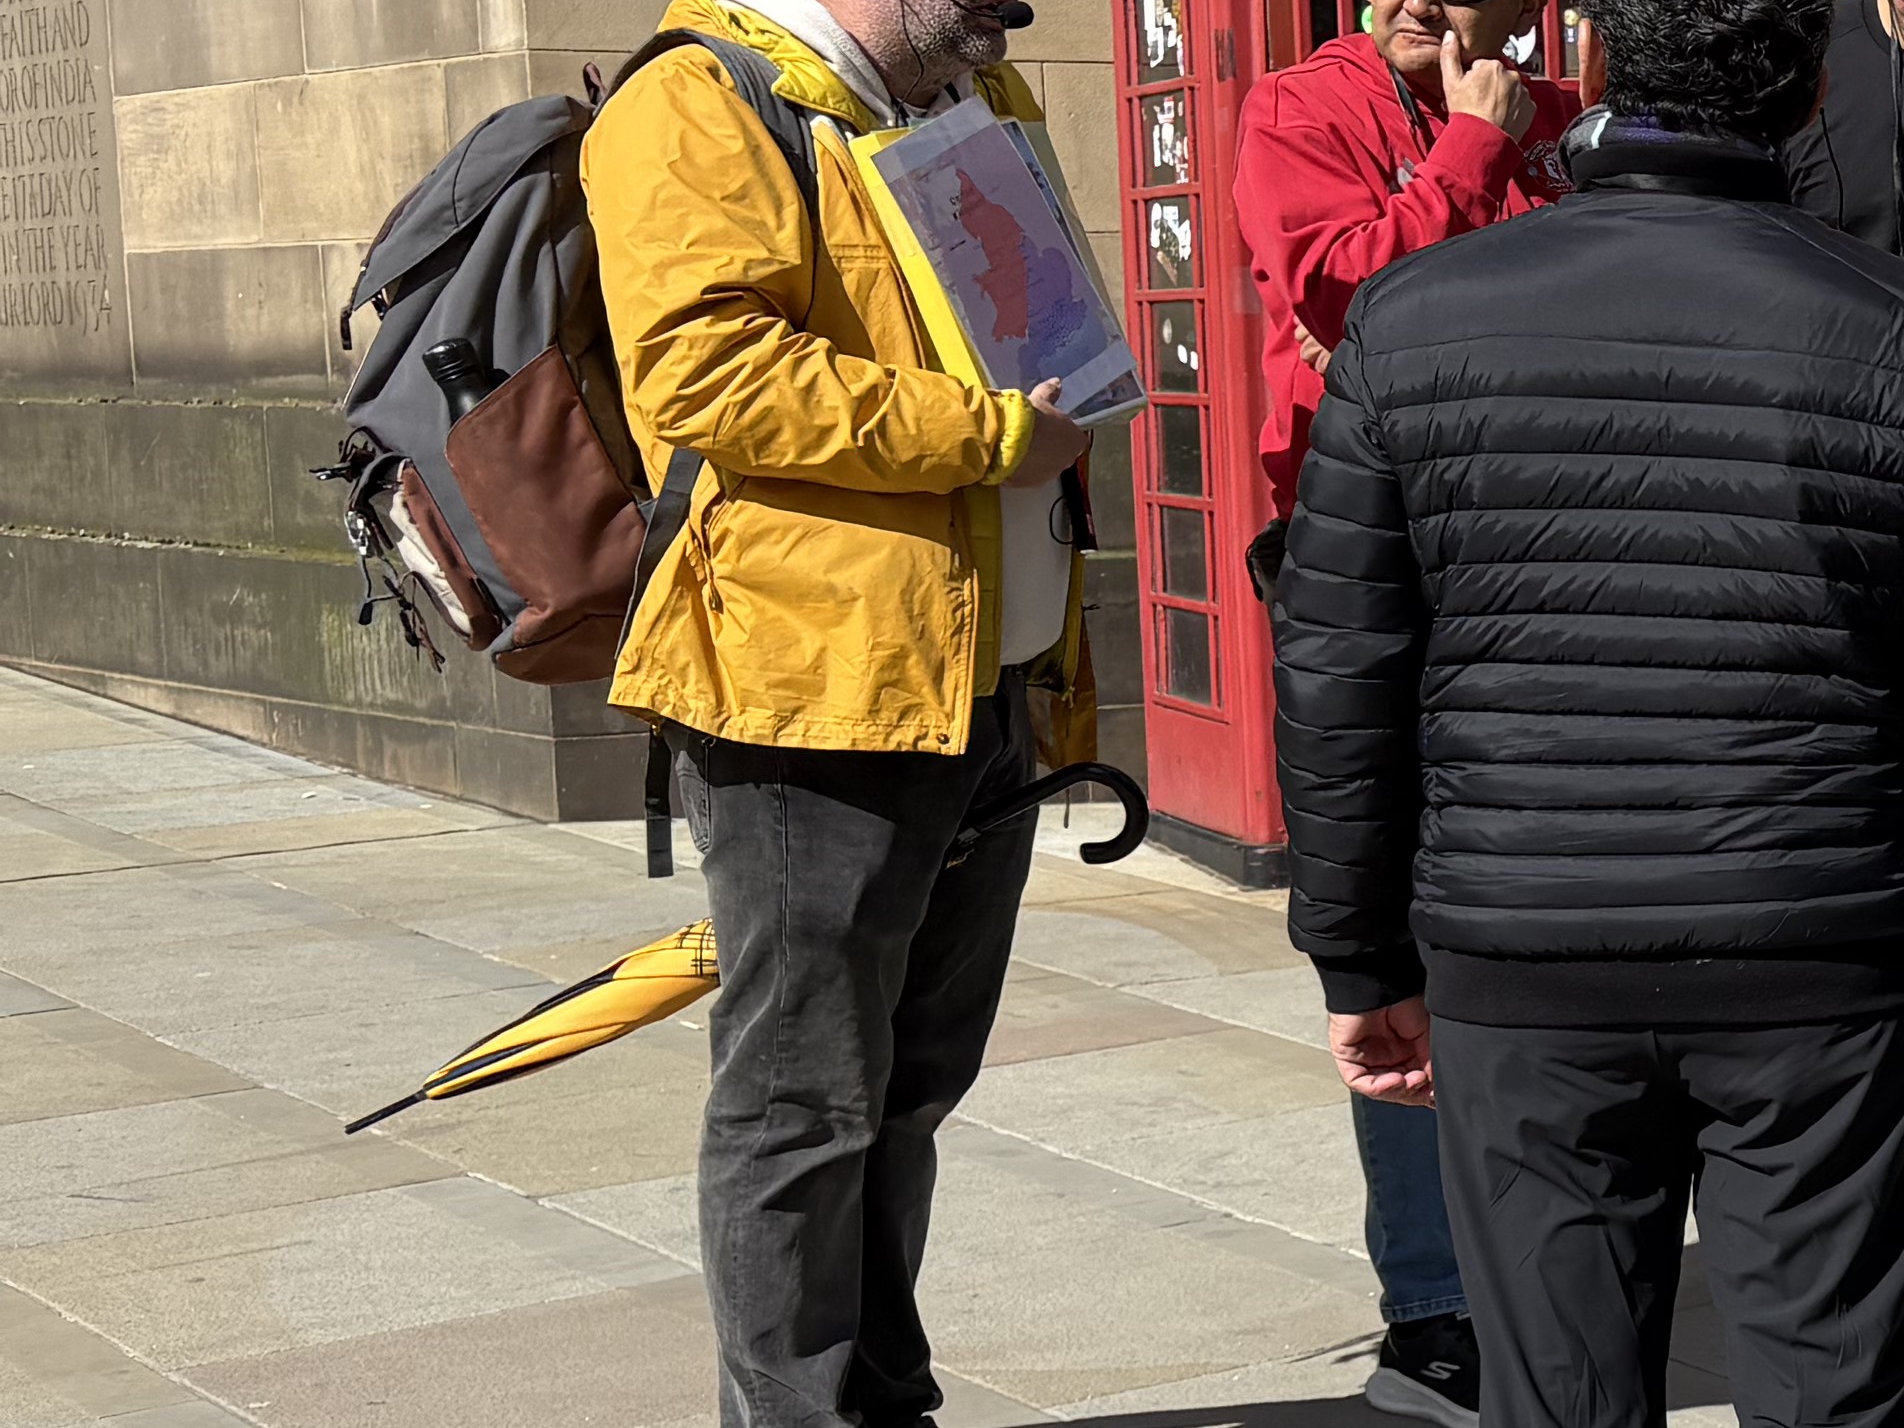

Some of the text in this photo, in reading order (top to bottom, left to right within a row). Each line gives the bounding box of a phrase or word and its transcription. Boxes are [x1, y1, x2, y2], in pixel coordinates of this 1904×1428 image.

[0, 0, 90, 60] FAITH AND
[22, 64, 40, 110] OF
[43, 58, 97, 109] INDIA
[38, 112, 98, 163] STONE
[39, 169, 73, 218] DAY
[79, 167, 101, 214] OF
[23, 226, 56, 274] THE
[60, 224, 108, 271] YEAR
[21, 281, 64, 327] LORD
